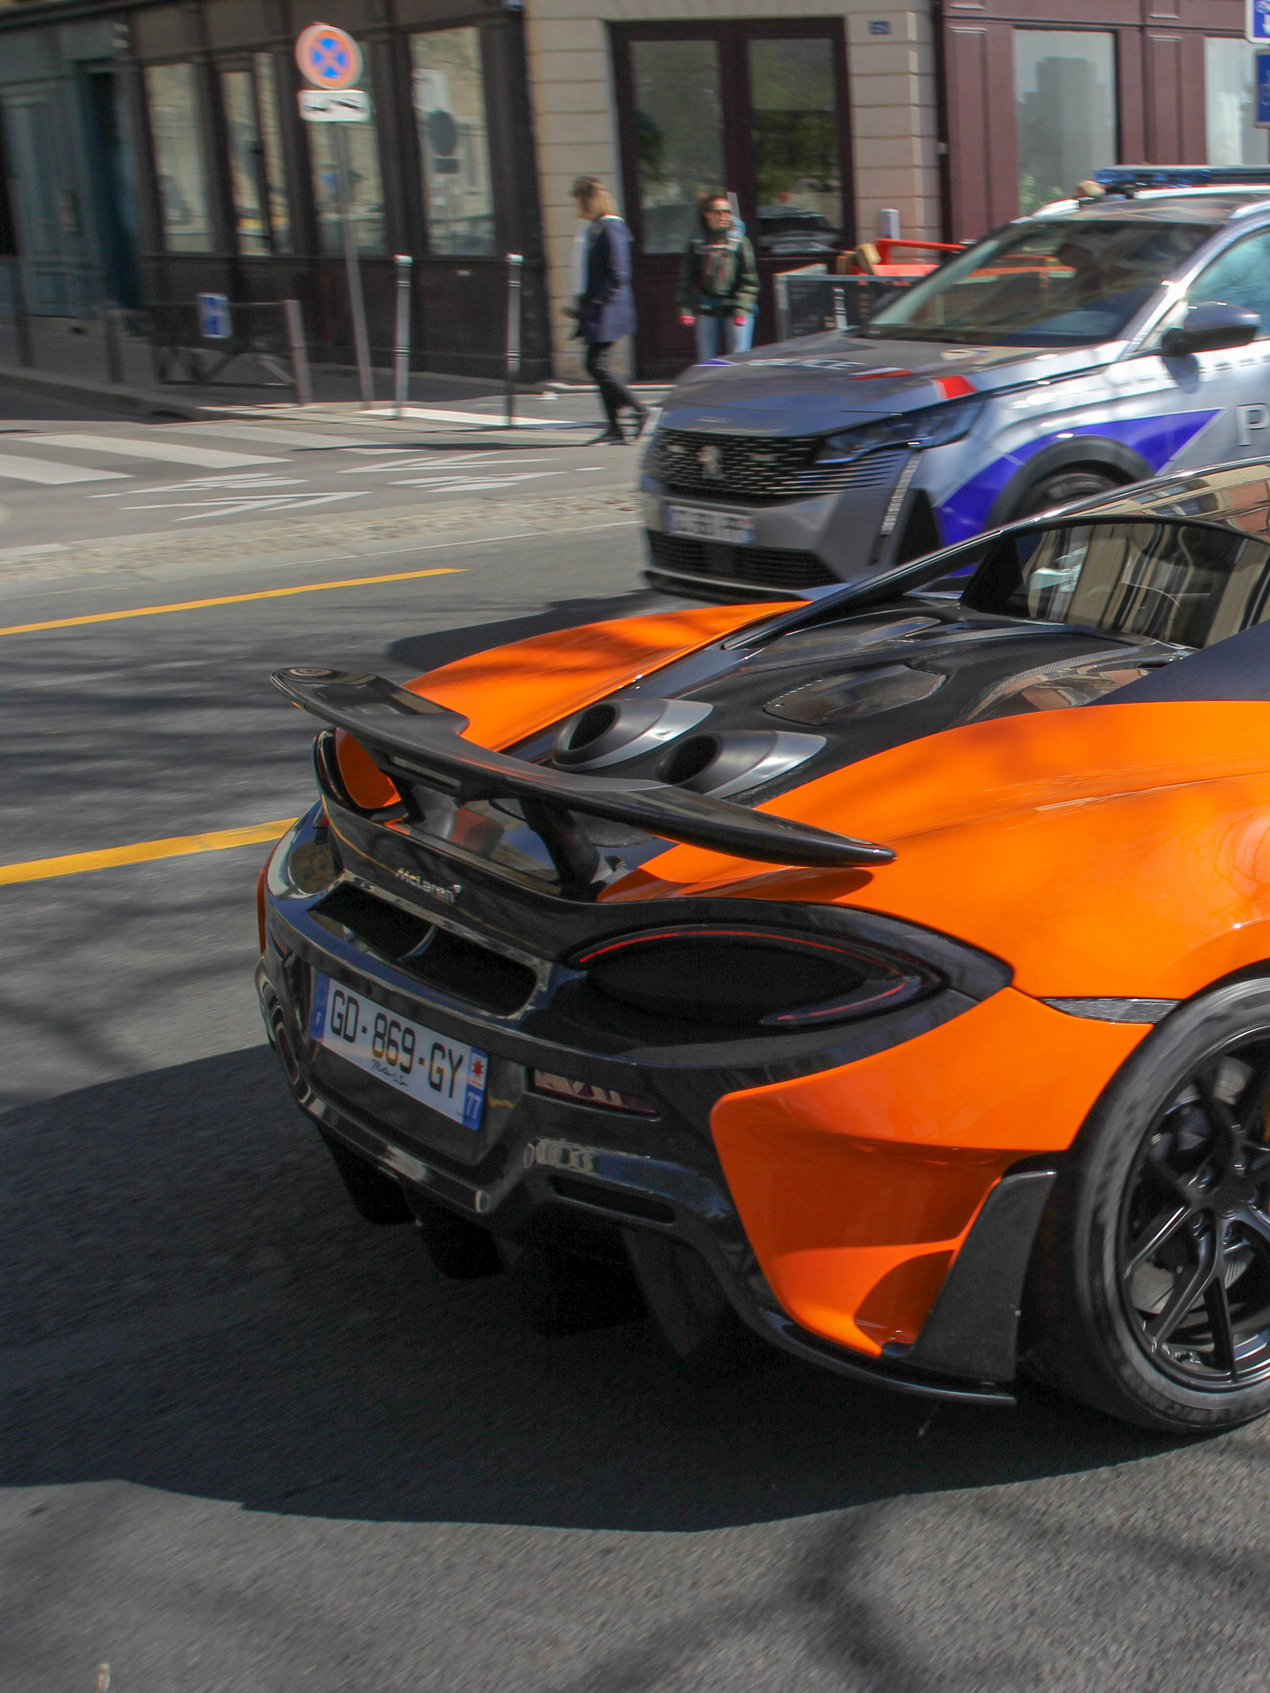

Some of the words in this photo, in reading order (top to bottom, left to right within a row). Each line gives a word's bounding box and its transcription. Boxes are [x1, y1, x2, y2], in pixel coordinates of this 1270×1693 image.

[395, 867, 455, 904] McLaren
[330, 988, 464, 1100] GD-869-GY
[466, 1090, 483, 1121] 77
